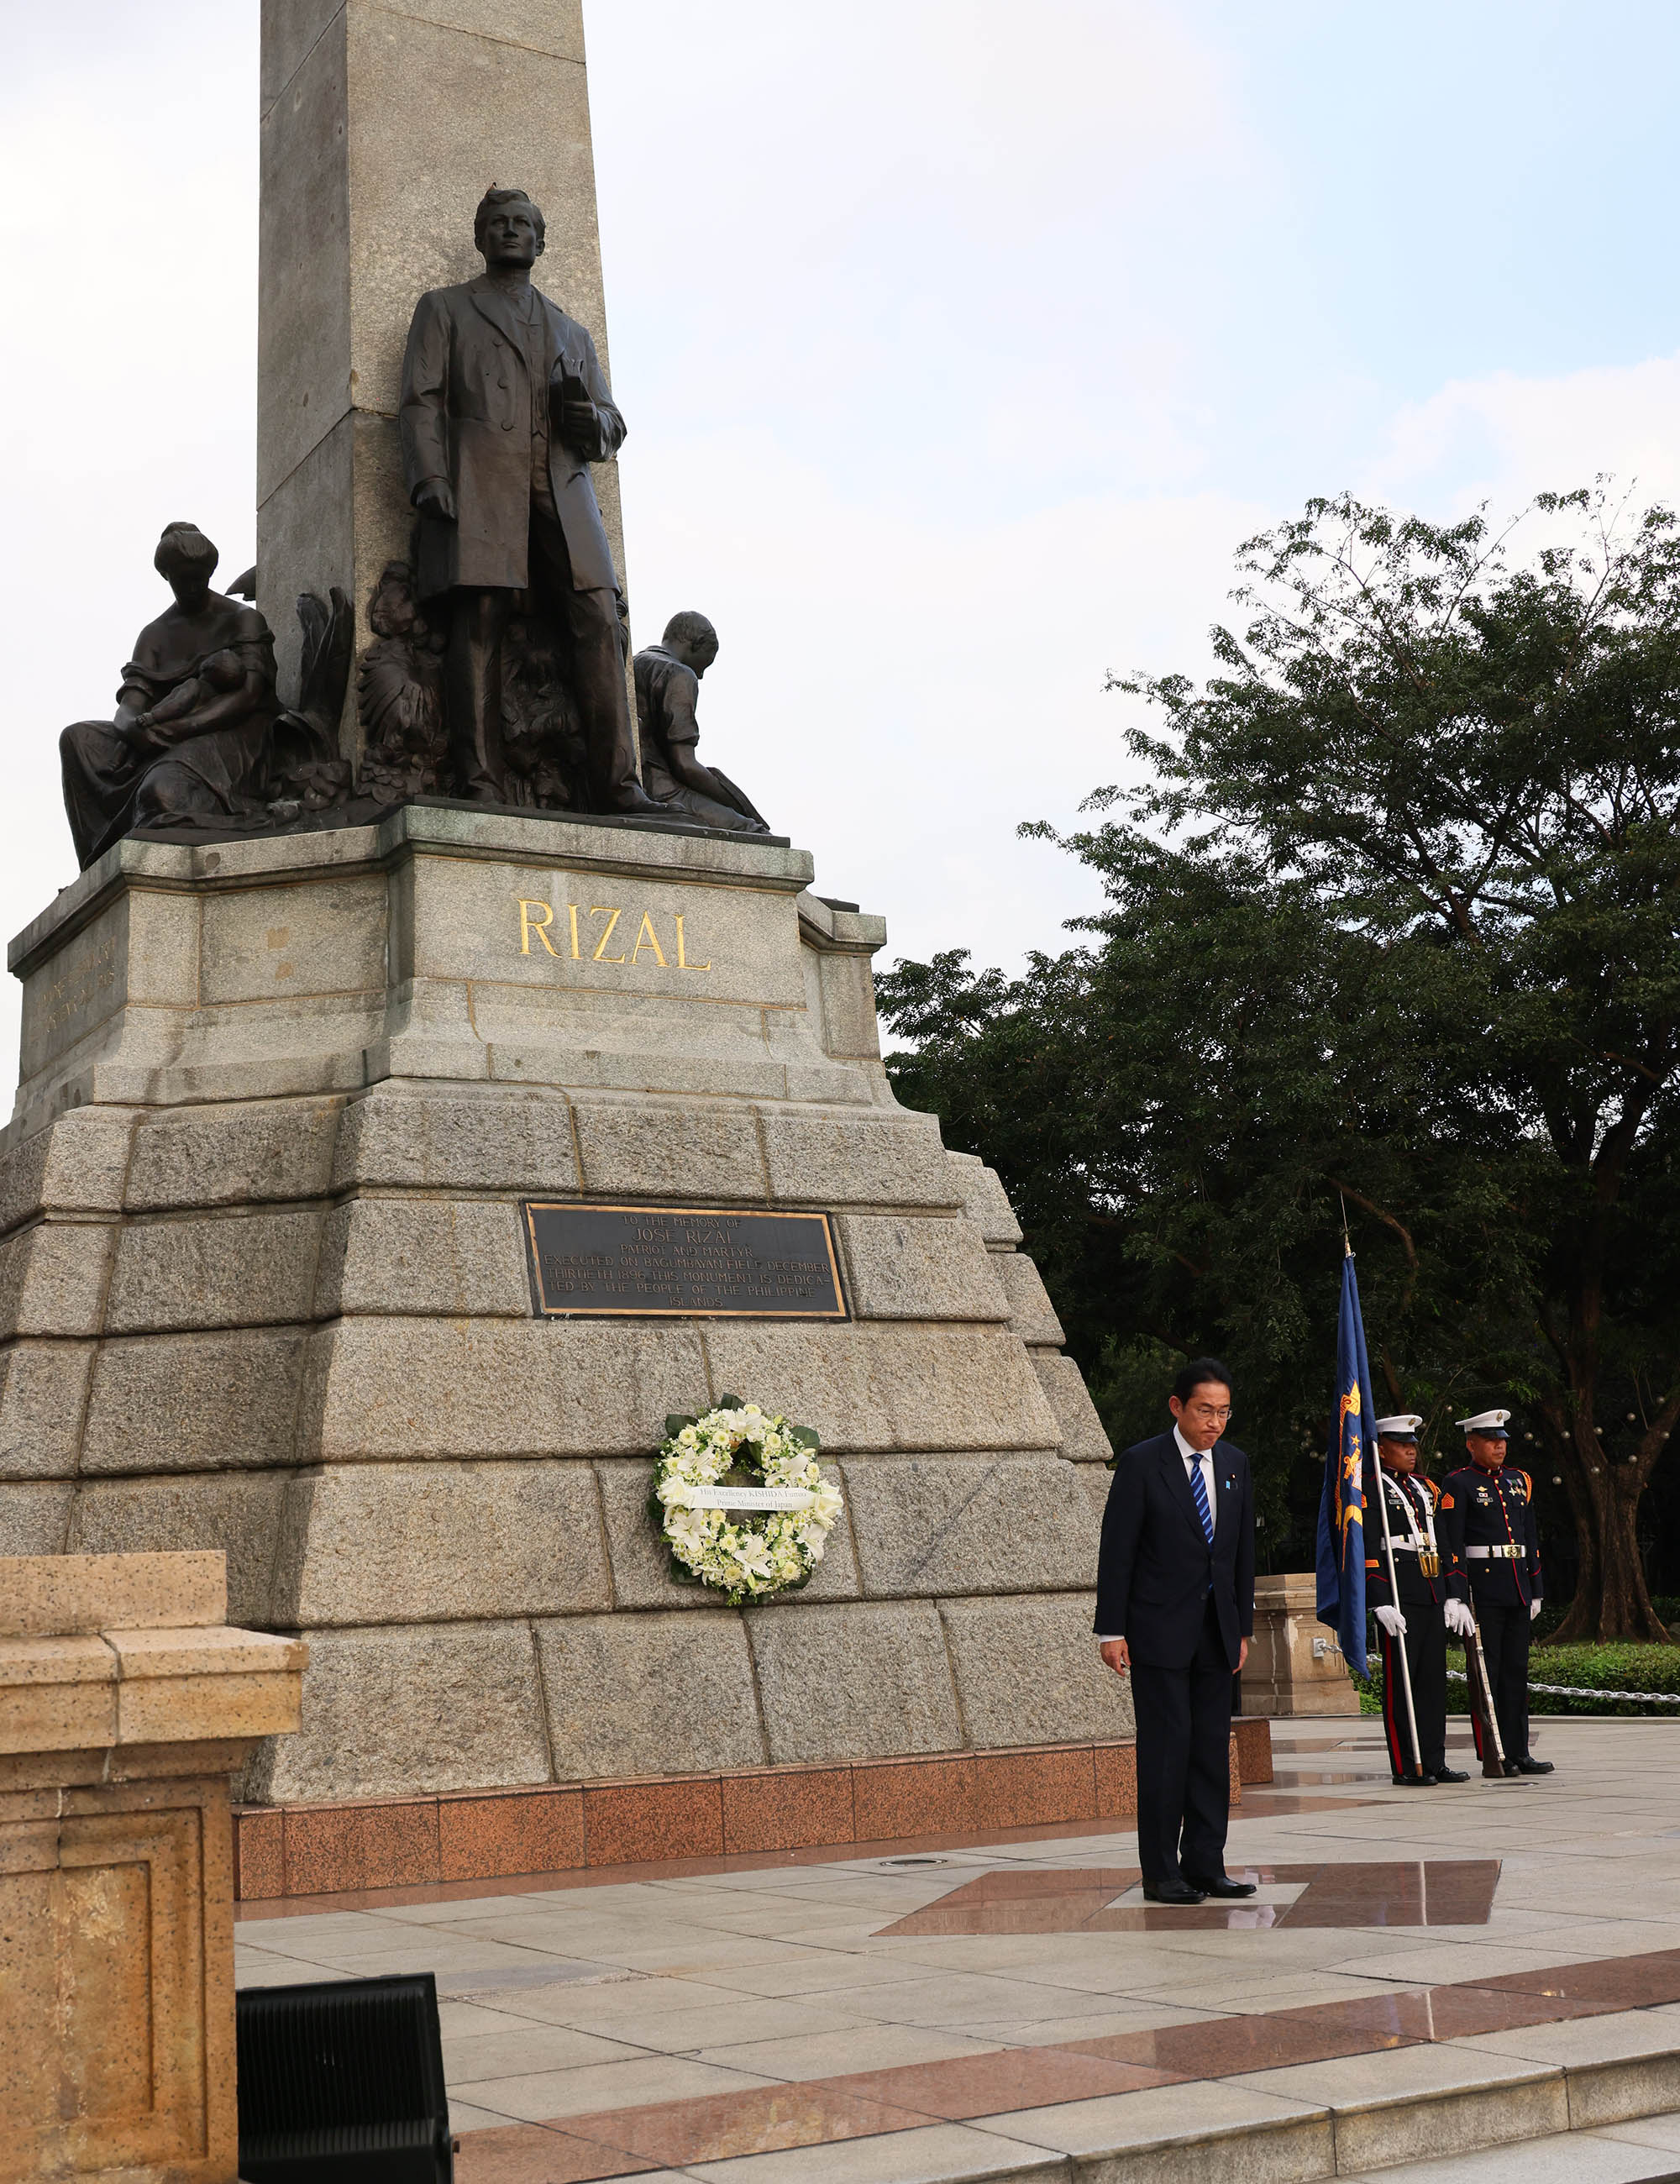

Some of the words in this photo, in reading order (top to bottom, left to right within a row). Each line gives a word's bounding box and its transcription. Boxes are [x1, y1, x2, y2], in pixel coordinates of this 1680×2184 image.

[517, 898, 711, 972] RIZAL
[622, 1215, 638, 1226] TO
[644, 1215, 668, 1227] THE
[672, 1216, 721, 1230] MEMORY
[727, 1218, 741, 1229] OF
[633, 1228, 676, 1243] JOSE
[685, 1230, 738, 1245] RIZAL
[619, 1243, 666, 1256] PATRIOT
[672, 1246, 697, 1257] AND
[702, 1246, 755, 1259] MARTYR
[543, 1254, 614, 1267] EXECUTED
[620, 1256, 638, 1268] ON
[644, 1257, 723, 1270] BAGUMBAYAN
[727, 1260, 762, 1271] FIELD
[767, 1261, 831, 1274] DECEMBER
[547, 1268, 613, 1281] THIRTIETH
[617, 1269, 646, 1280] 1896
[651, 1270, 679, 1282] THIS
[683, 1272, 753, 1284] MONUMENT
[759, 1274, 772, 1285] IS
[776, 1274, 832, 1286] DEDICA-
[549, 1280, 575, 1292] TED
[580, 1281, 596, 1293] BY
[604, 1282, 630, 1294] THE
[637, 1283, 685, 1295] PEOPLE
[691, 1284, 706, 1295] OF
[716, 1284, 741, 1296] THE
[747, 1286, 817, 1299] PHILIPPINE
[669, 1296, 723, 1308] ISLANDS
[713, 1488, 747, 1499] Excellency
[748, 1489, 782, 1498] KISHIDA
[717, 1499, 736, 1507] Prime
[738, 1499, 764, 1508] Minister
[774, 1501, 793, 1509] Japan
